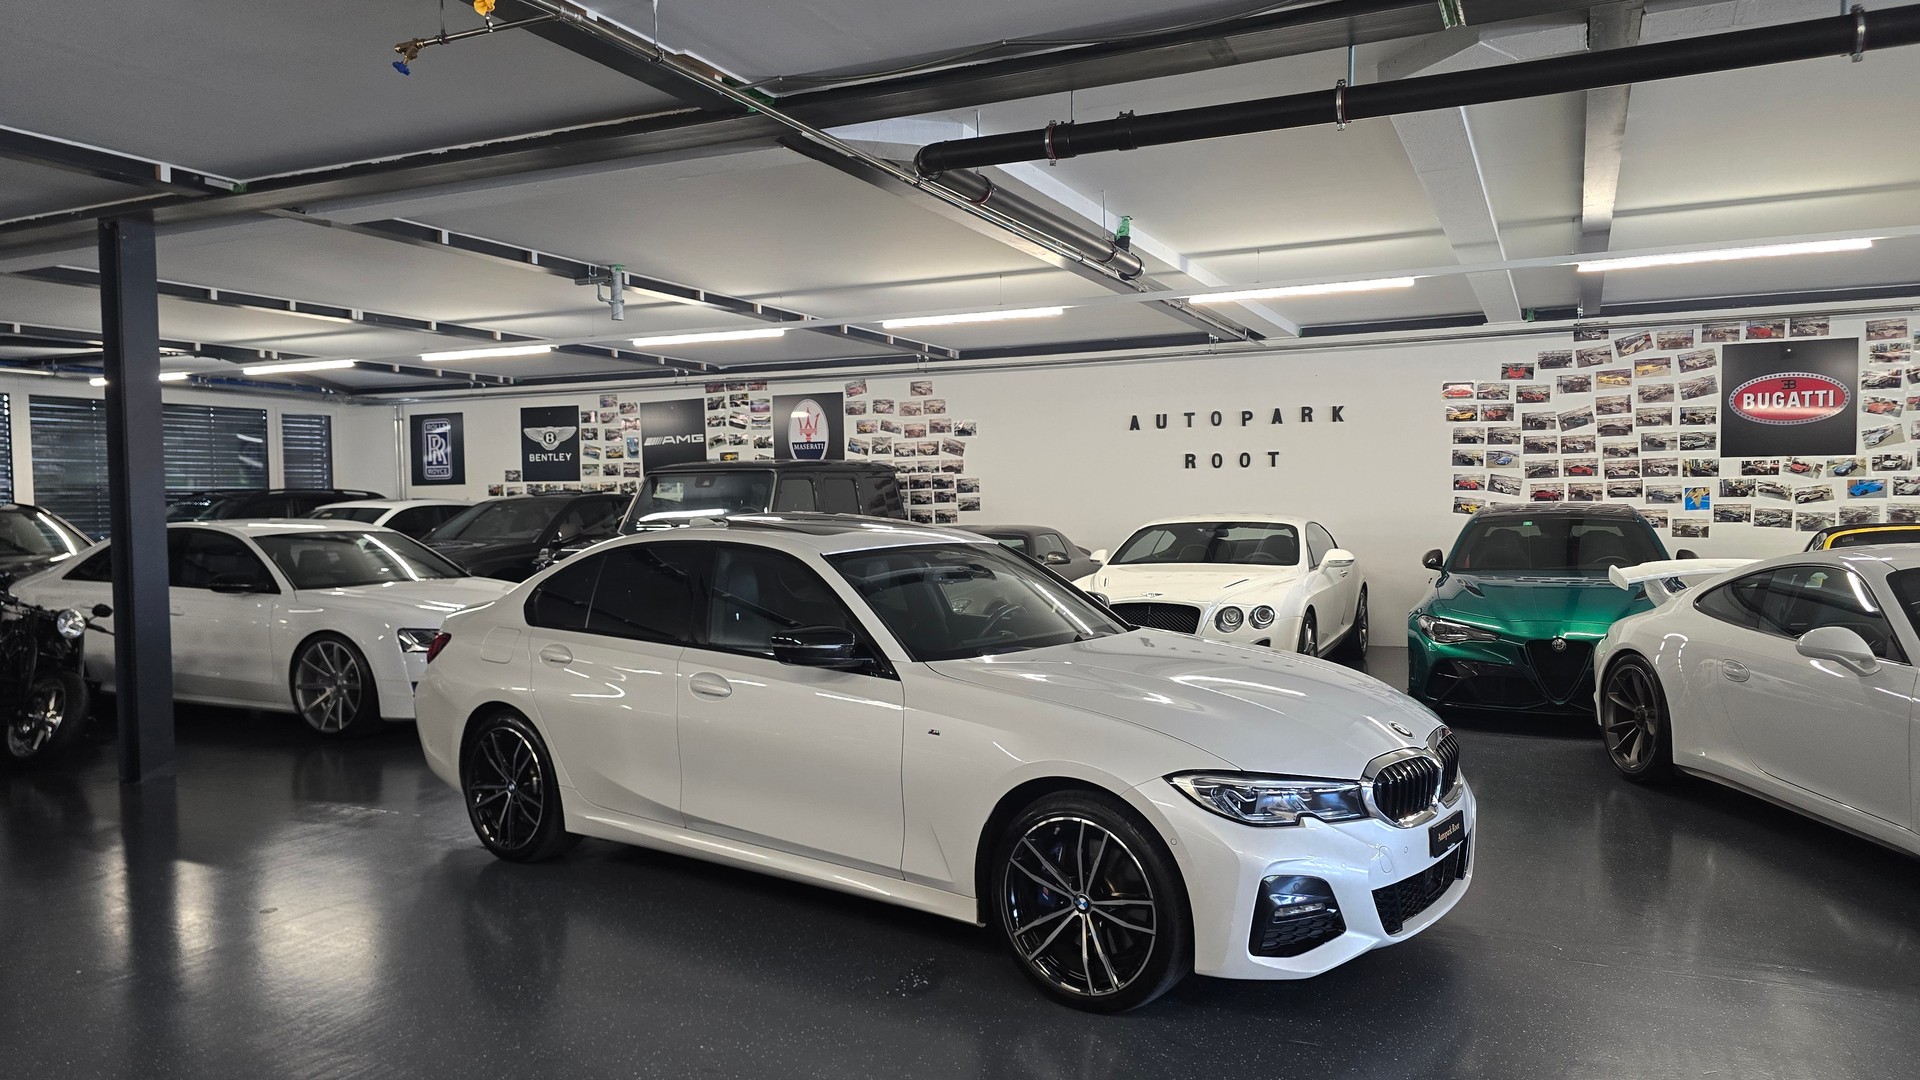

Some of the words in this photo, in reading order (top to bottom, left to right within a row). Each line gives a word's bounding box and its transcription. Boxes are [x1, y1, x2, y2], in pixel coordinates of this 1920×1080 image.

[1742, 389, 1836, 410] BUGATTI
[1129, 405, 1345, 431] AUTOPARK
[662, 433, 705, 445] AMG
[529, 452, 572, 462] BENTLEY
[1184, 451, 1280, 469] ROOT
[427, 467, 448, 476] ROYCE
